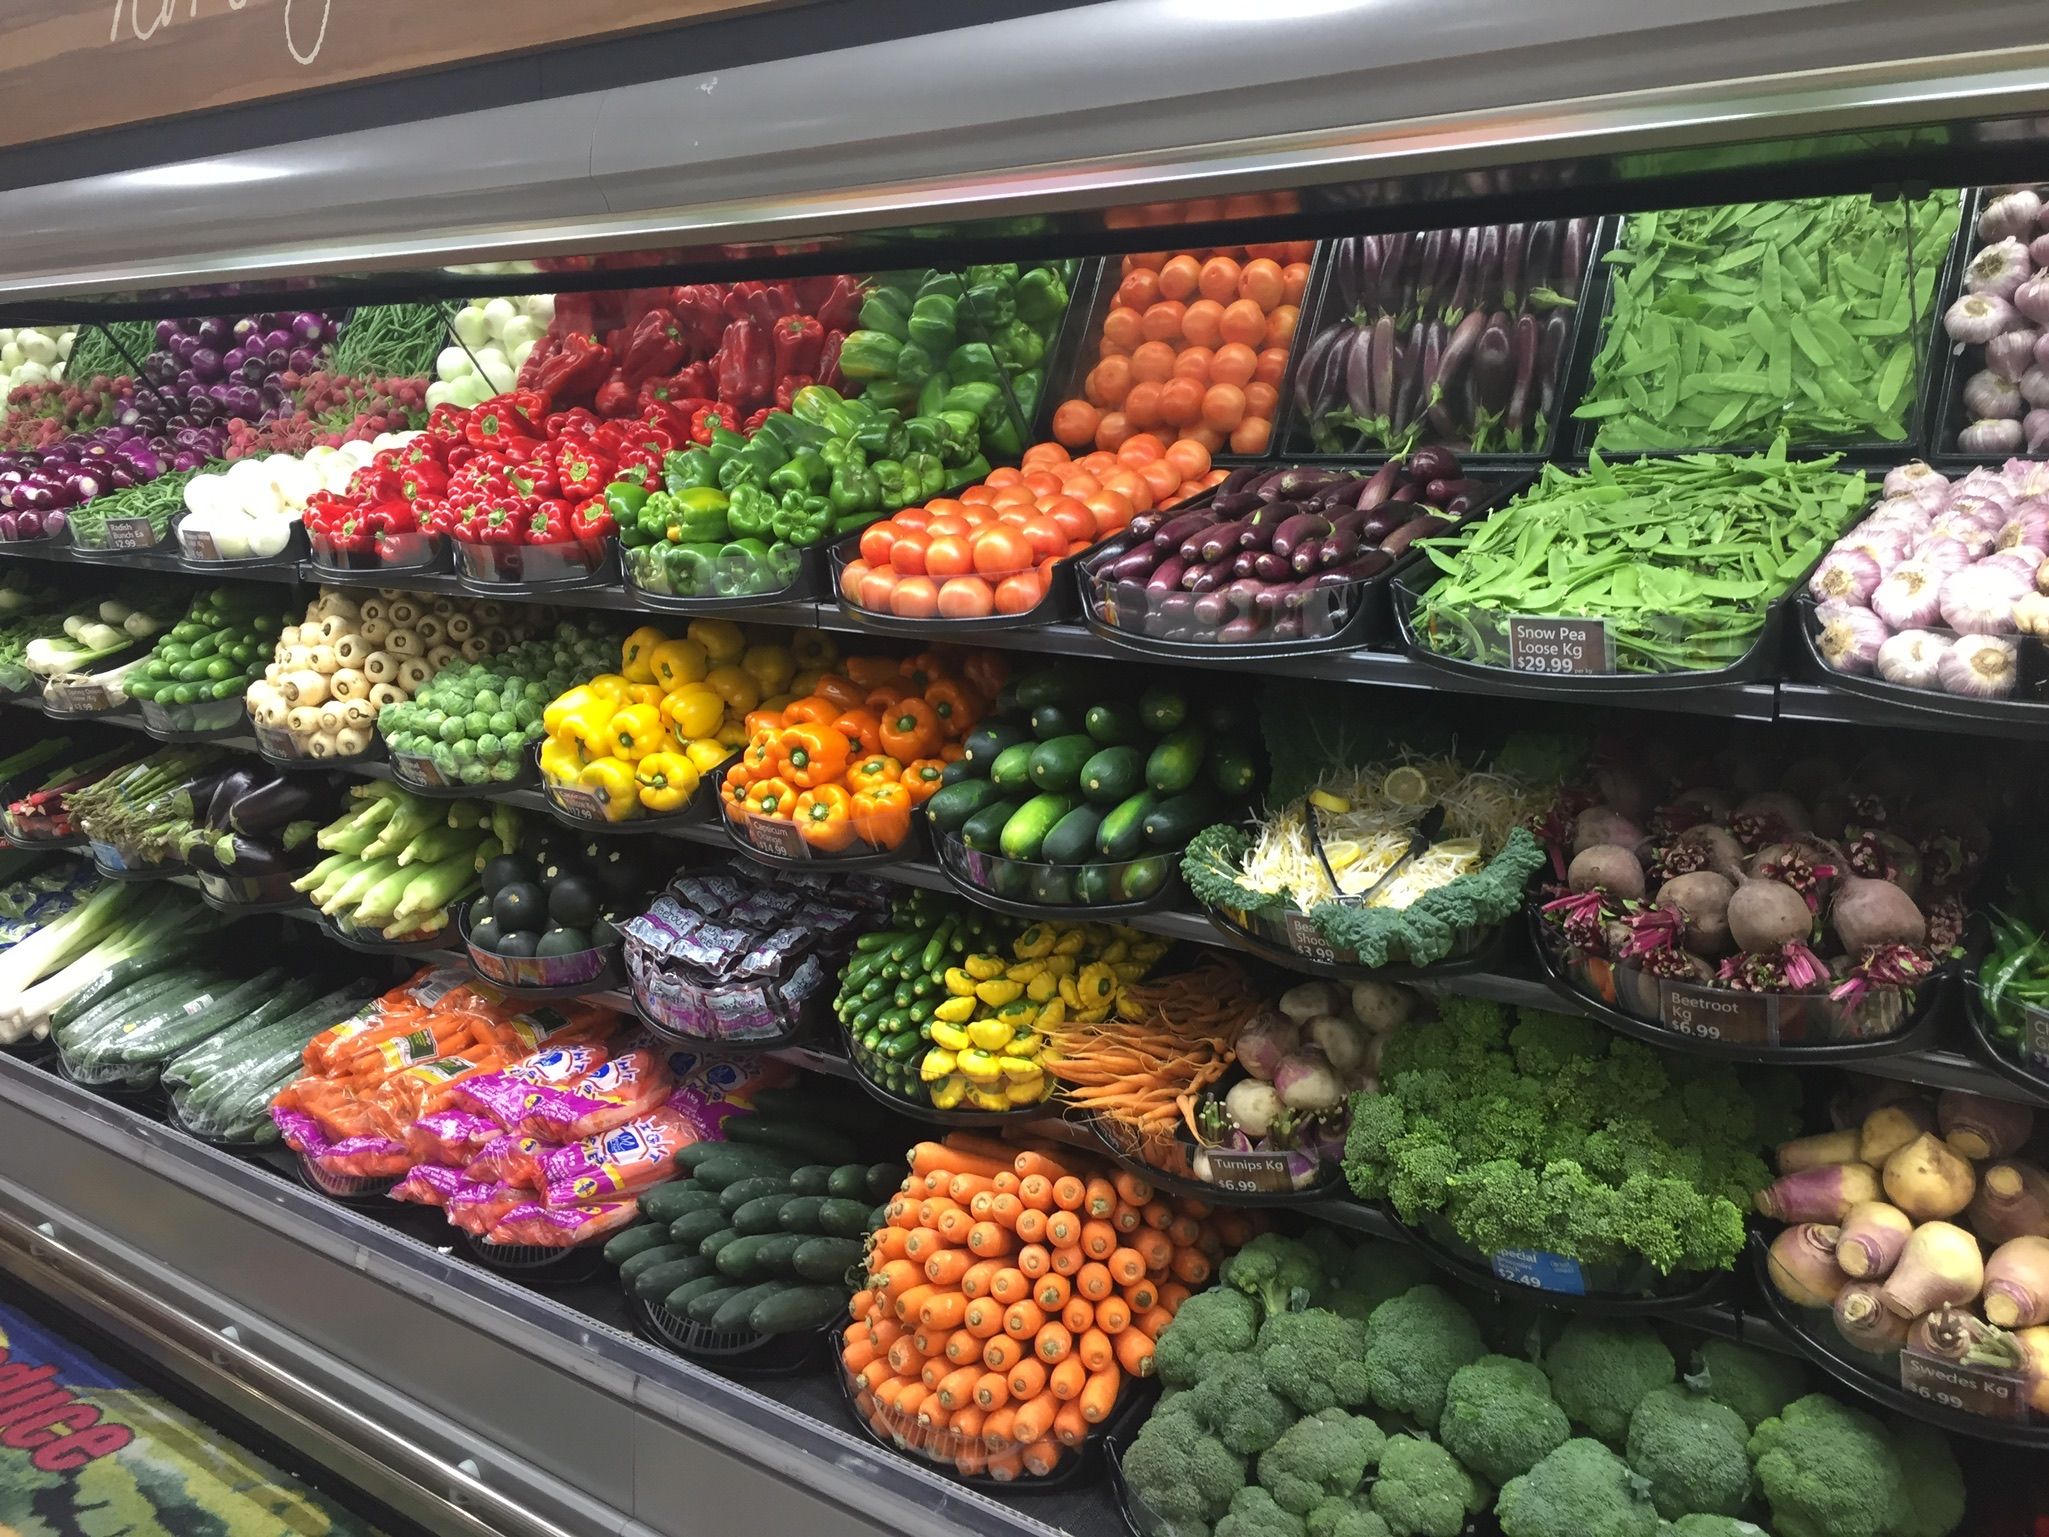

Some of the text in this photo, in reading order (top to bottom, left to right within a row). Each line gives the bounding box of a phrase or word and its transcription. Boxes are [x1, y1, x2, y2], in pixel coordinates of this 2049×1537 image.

[110, 523, 132, 531] Radish
[112, 532, 134, 540] Bunch
[1517, 625, 1586, 641] Snow Pea
[1518, 640, 1582, 659] Loose Kg
[1517, 656, 1573, 673] $29.99
[1294, 920, 1316, 933] Bea
[1297, 945, 1335, 960] $3.99
[1671, 992, 1739, 1014] Beetroot
[1672, 1006, 1692, 1022] Kg
[1671, 1020, 1720, 1039] $6.99
[1214, 1159, 1284, 1173] Turnips Kg
[1218, 1179, 1257, 1192] $6.99
[1498, 1248, 1538, 1263] pecial
[1498, 1268, 1541, 1288] $2.49
[1910, 1360, 2009, 1399] Swedes Kg
[1910, 1382, 1963, 1409] $6.99
